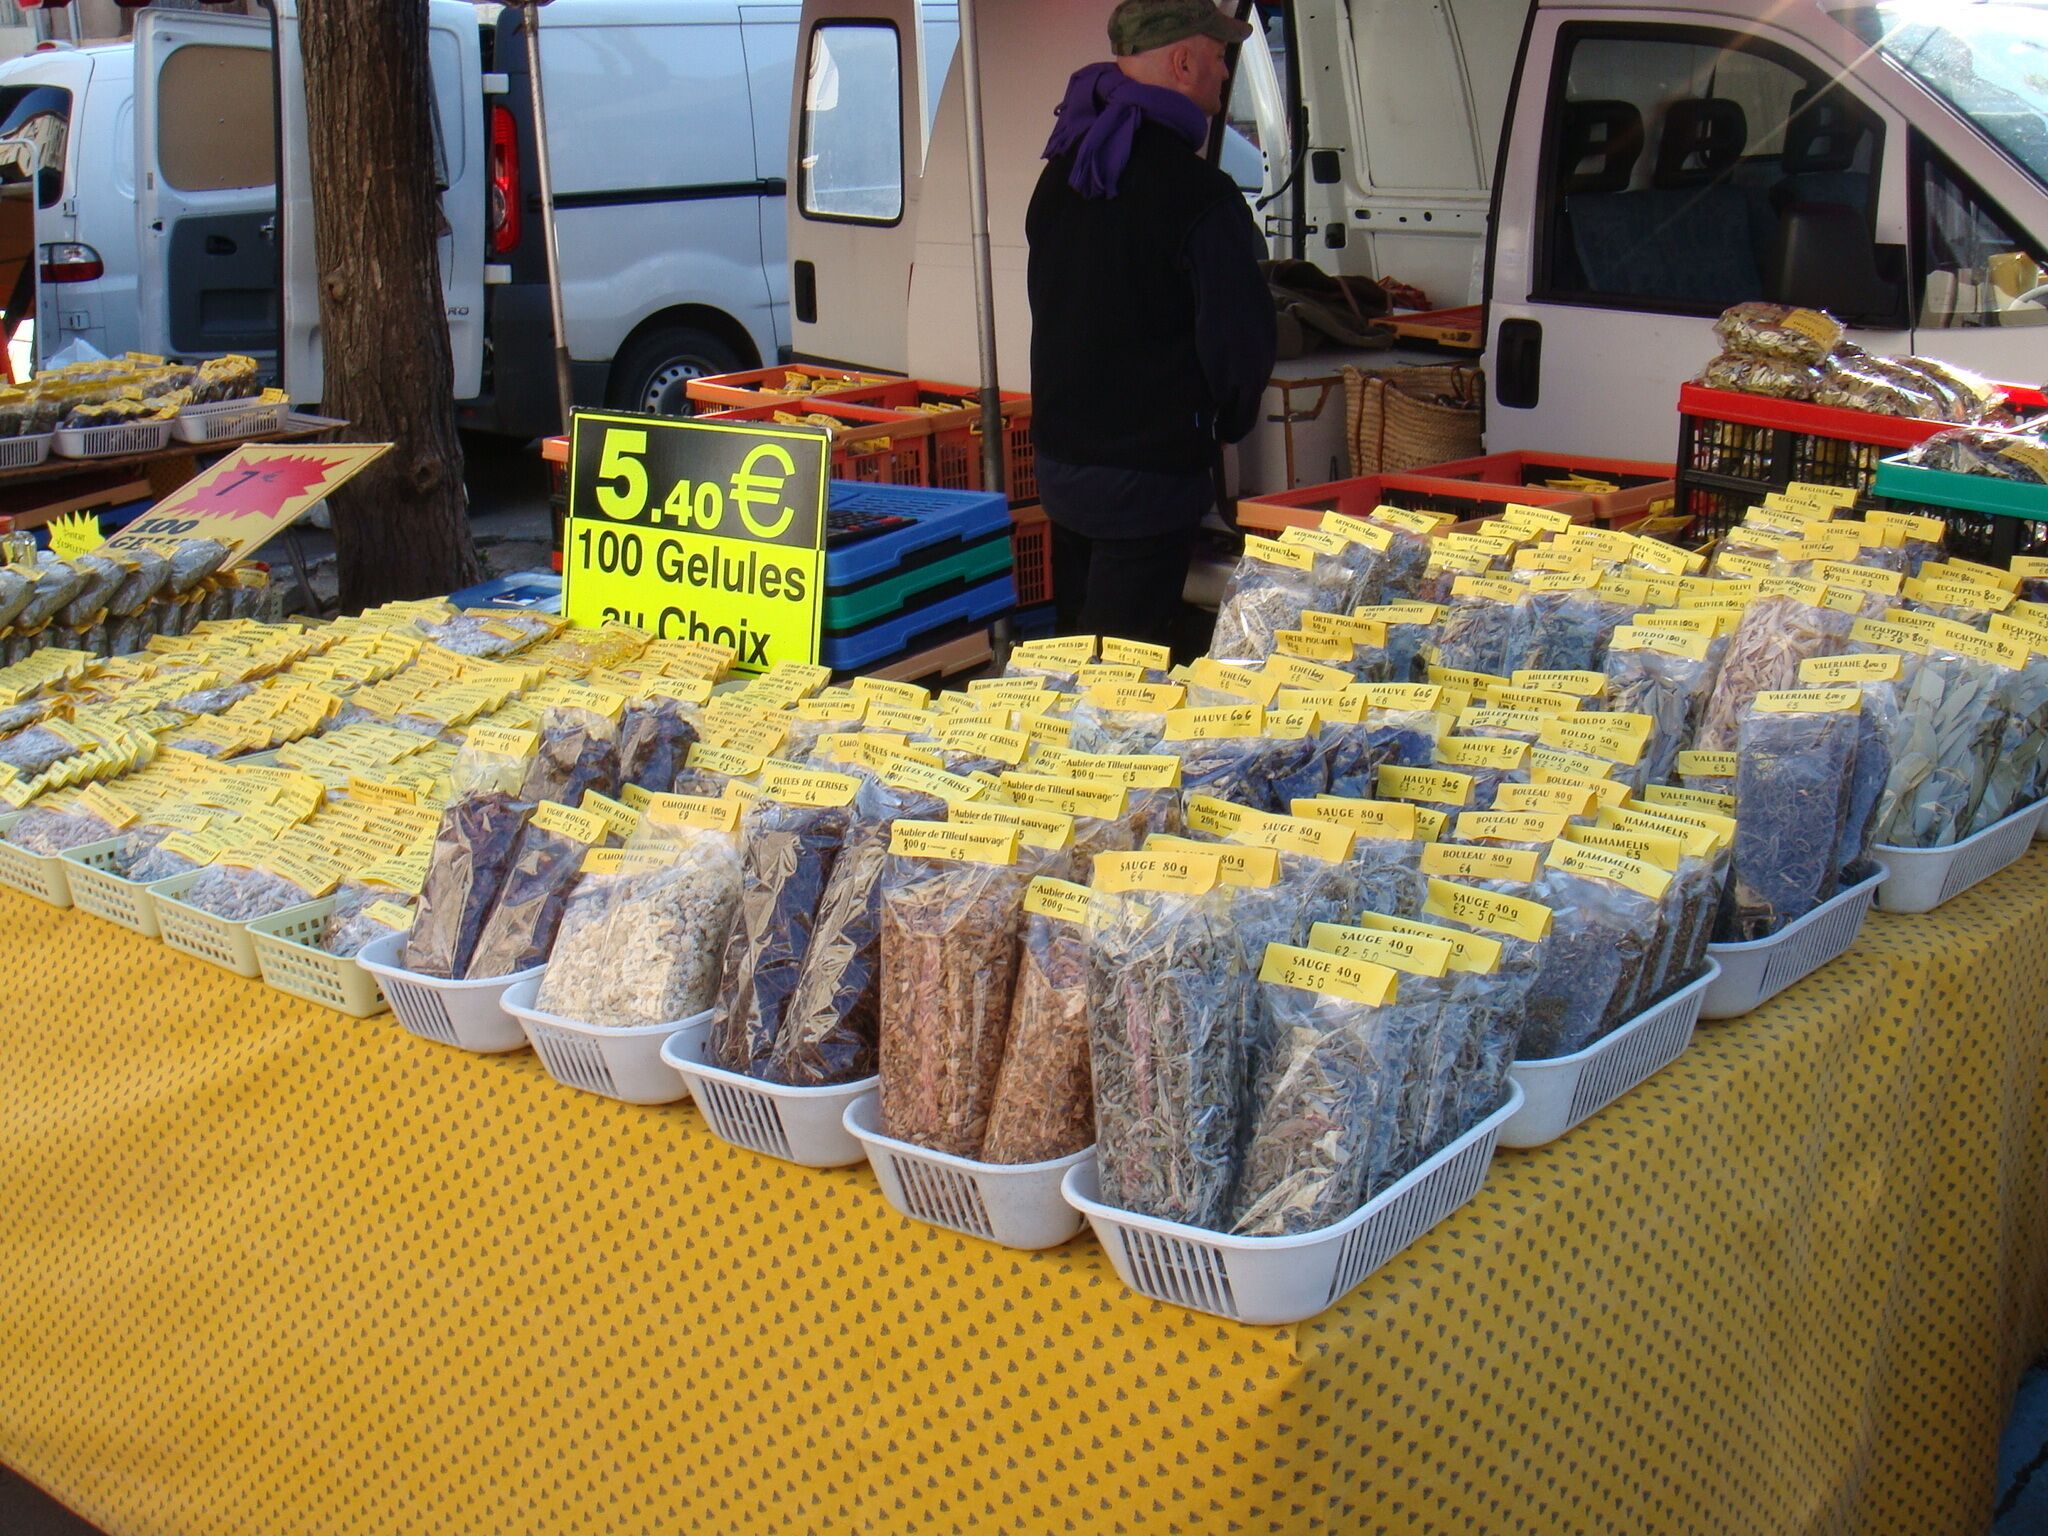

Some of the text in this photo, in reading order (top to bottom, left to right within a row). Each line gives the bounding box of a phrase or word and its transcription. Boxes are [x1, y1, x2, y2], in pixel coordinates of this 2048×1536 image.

[129, 518, 200, 534] 100
[579, 529, 805, 601] 100 Gelules
[1824, 565, 1890, 581] COSSES HARICOTS
[1937, 584, 1982, 597] EUCALYPTUS
[1694, 600, 1724, 608] OLIVIER
[658, 606, 771, 666] Choix
[1864, 624, 1909, 639] EUCALYPTUS
[1946, 630, 1993, 649] EUCALYPTUS
[1814, 661, 1861, 669] VALERIANE
[1528, 673, 1589, 683] MILLEPERTUIS
[1372, 687, 1406, 696] MAUVE
[586, 692, 609, 703] ROUGE
[1302, 696, 1334, 706] MAUVE
[1501, 692, 1562, 707] MILLEPERTUIS
[1194, 714, 1228, 723] MAUVE
[1573, 717, 1606, 725] BOLDO
[500, 731, 522, 743] ROUGE
[977, 731, 989, 739] DE
[989, 734, 1019, 748] CERISES
[1561, 728, 1595, 741] BOLDO
[1462, 743, 1495, 753] MAUVE
[1532, 752, 1565, 762] BOLDO
[1107, 759, 1133, 770] Tilleul
[891, 763, 971, 794] QUEUES DE CERISES
[1123, 771, 1135, 782] €5
[1403, 775, 1436, 786] MAUVE
[1547, 775, 1584, 787] BOULEAU
[773, 776, 849, 792] QUEUES DE CERISES
[1035, 784, 1047, 792] de
[1048, 785, 1076, 796] Tilleul
[1512, 788, 1550, 797] BOULEAU
[1525, 798, 1537, 807] €4
[1660, 792, 1716, 805] VALERIANE
[662, 800, 708, 812] CAMOMILLE
[1062, 802, 1075, 813] €5
[1218, 809, 1228, 818] de
[1316, 807, 1354, 818] SAUGE
[565, 811, 592, 828] ROUGE
[981, 813, 993, 821] de
[993, 814, 1020, 825] Tilleul
[1476, 816, 1518, 825] BOULEAU
[1644, 809, 1706, 828] HAMAMELIS
[1262, 822, 1295, 833] SAUGE
[1484, 826, 1497, 834] €4
[1624, 816, 1688, 839] HAMAMELIS
[928, 830, 939, 838] de
[941, 831, 968, 841] Tilleul
[1583, 835, 1650, 850] HAMAMELIS
[951, 848, 965, 859] €5
[1443, 849, 1486, 860] BOULEAU
[1120, 861, 1156, 871] SAUGE
[1577, 850, 1641, 874] HAMAMELIS
[1459, 863, 1471, 874] €4
[1065, 891, 1077, 901] de
[1453, 892, 1490, 909] SAUGE
[1340, 931, 1382, 945] SAUGE
[1292, 956, 1331, 973] SAUGE
